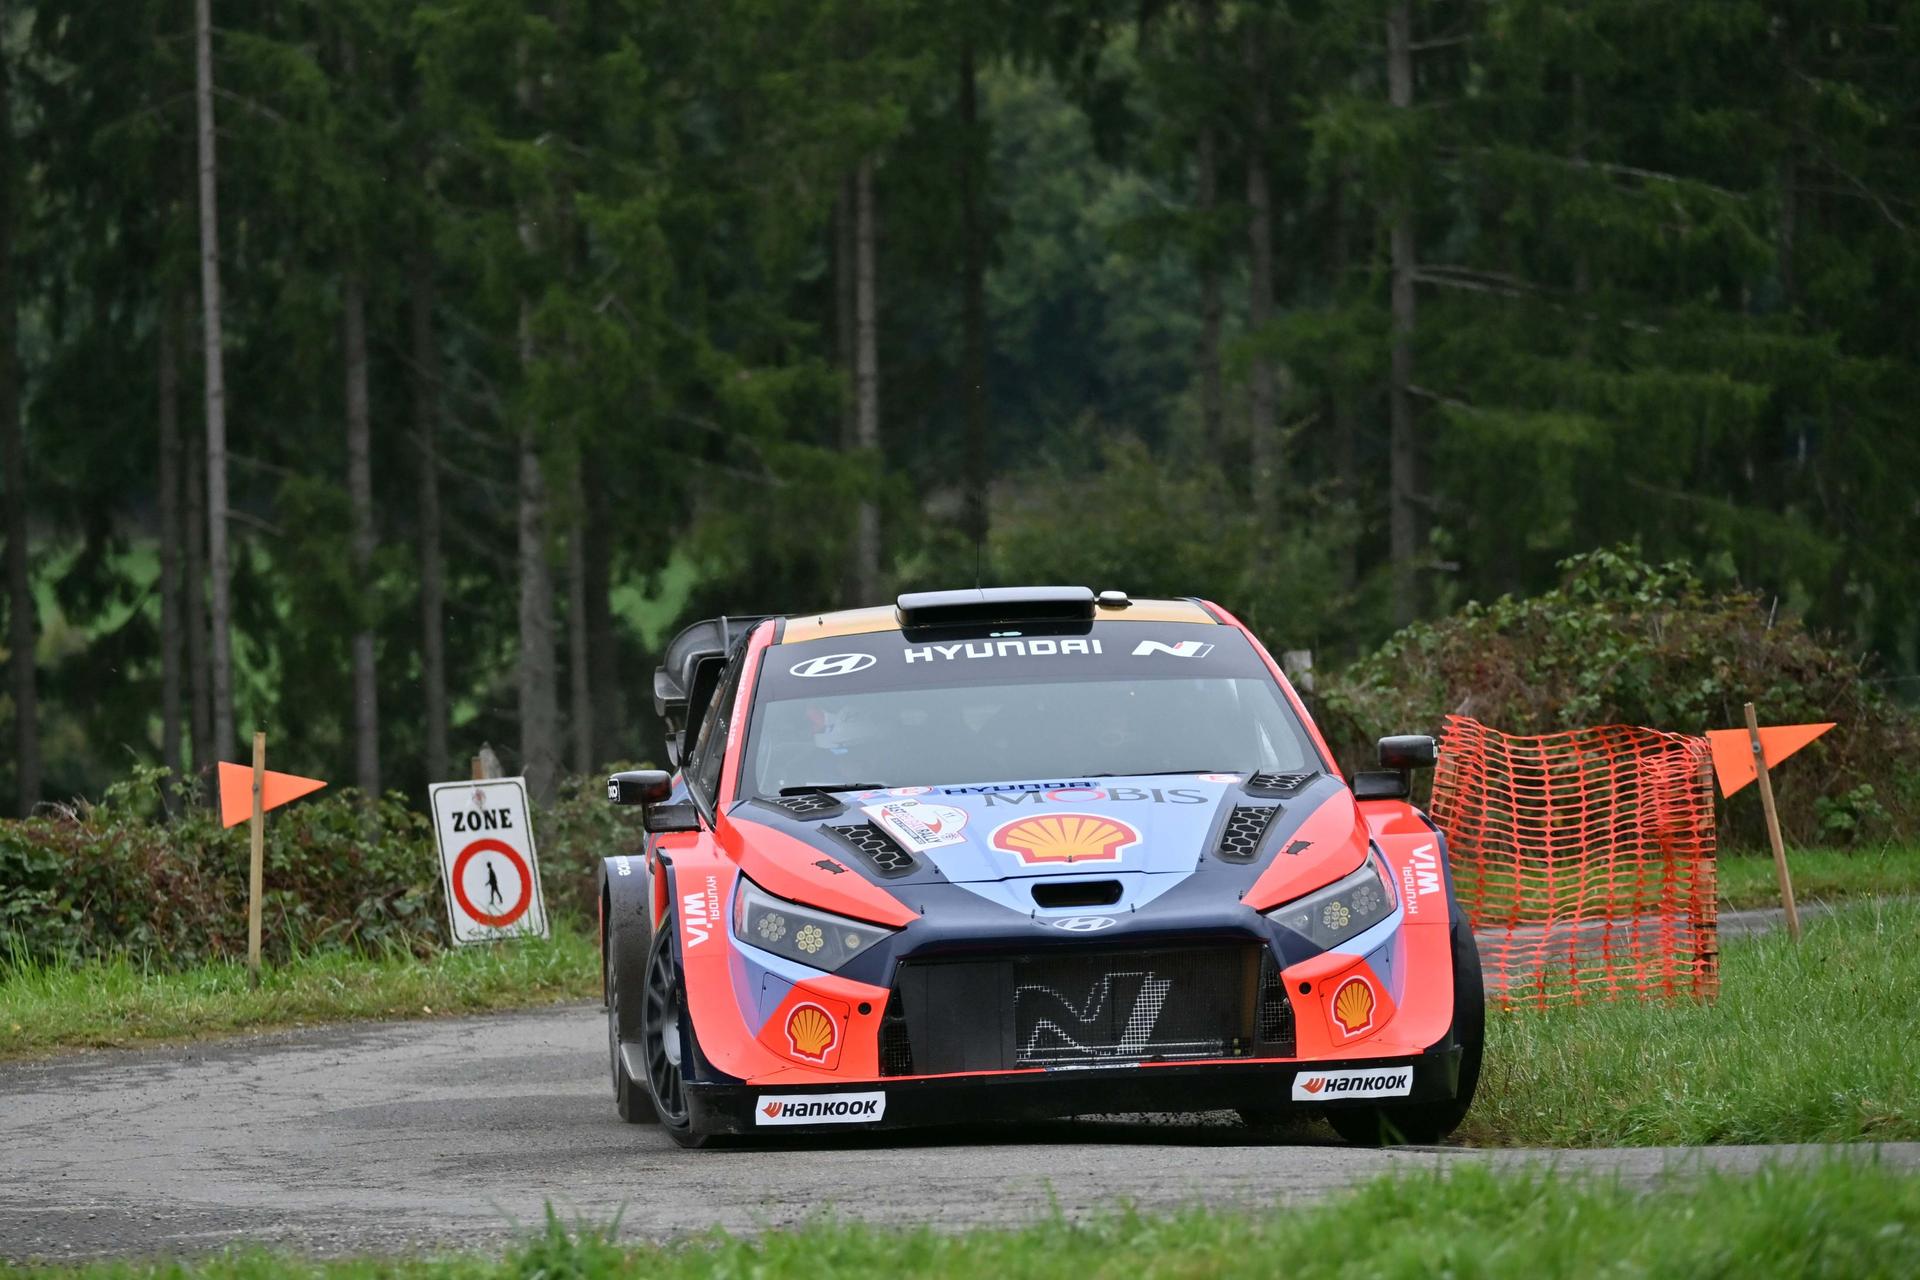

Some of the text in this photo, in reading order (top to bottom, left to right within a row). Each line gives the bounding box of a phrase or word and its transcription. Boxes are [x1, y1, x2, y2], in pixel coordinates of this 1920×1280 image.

[904, 639, 1102, 663] HYUNDAI
[945, 782, 1099, 795] HYUNDAI
[984, 787, 1208, 807] MOBIS
[452, 808, 513, 832] ZONE
[706, 876, 720, 920] HYUNDAI
[1403, 867, 1419, 914] HYUNDAI
